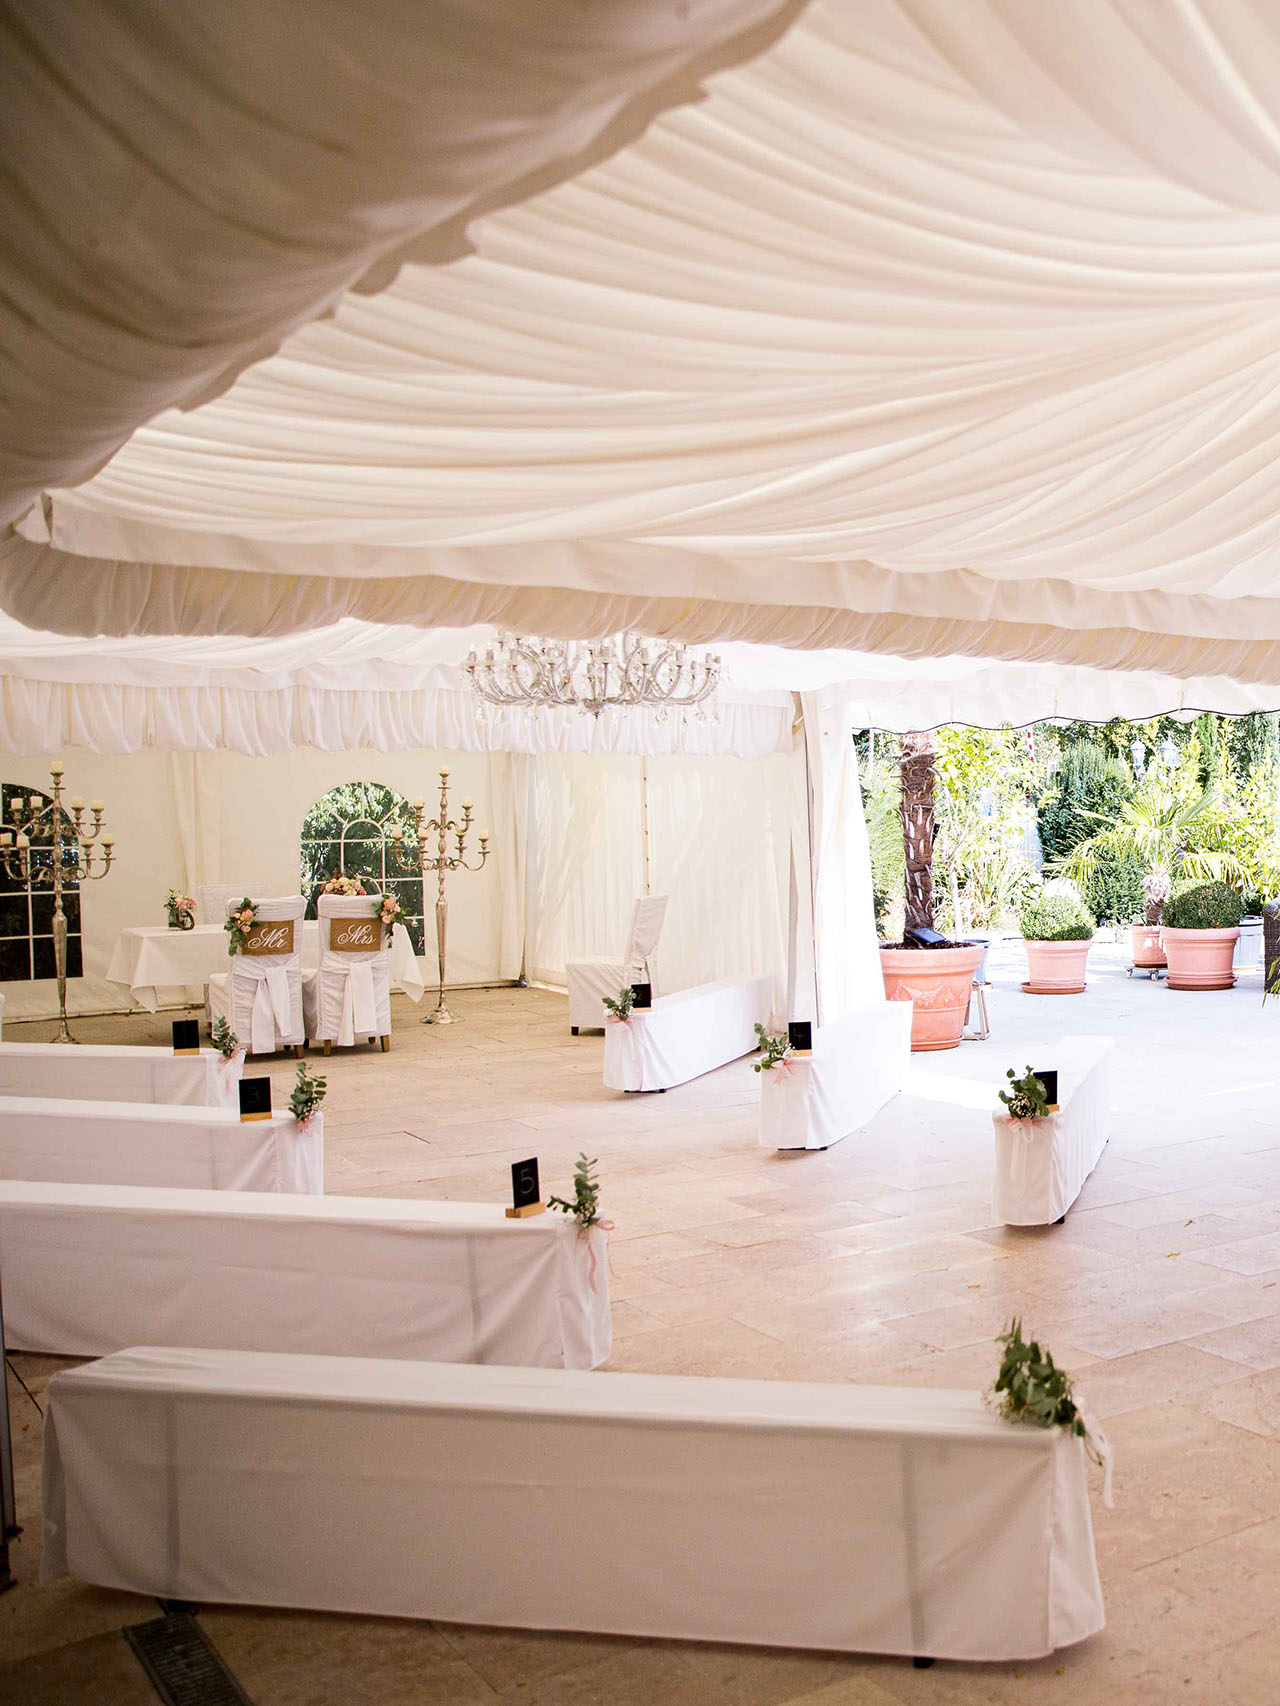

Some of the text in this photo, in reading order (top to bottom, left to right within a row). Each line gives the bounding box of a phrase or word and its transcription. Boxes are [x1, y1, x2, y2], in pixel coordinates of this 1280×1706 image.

[247, 927, 289, 949] Mr
[337, 924, 376, 945] Mrs
[248, 1086, 260, 1104] 3
[520, 1168, 535, 1194] 5
